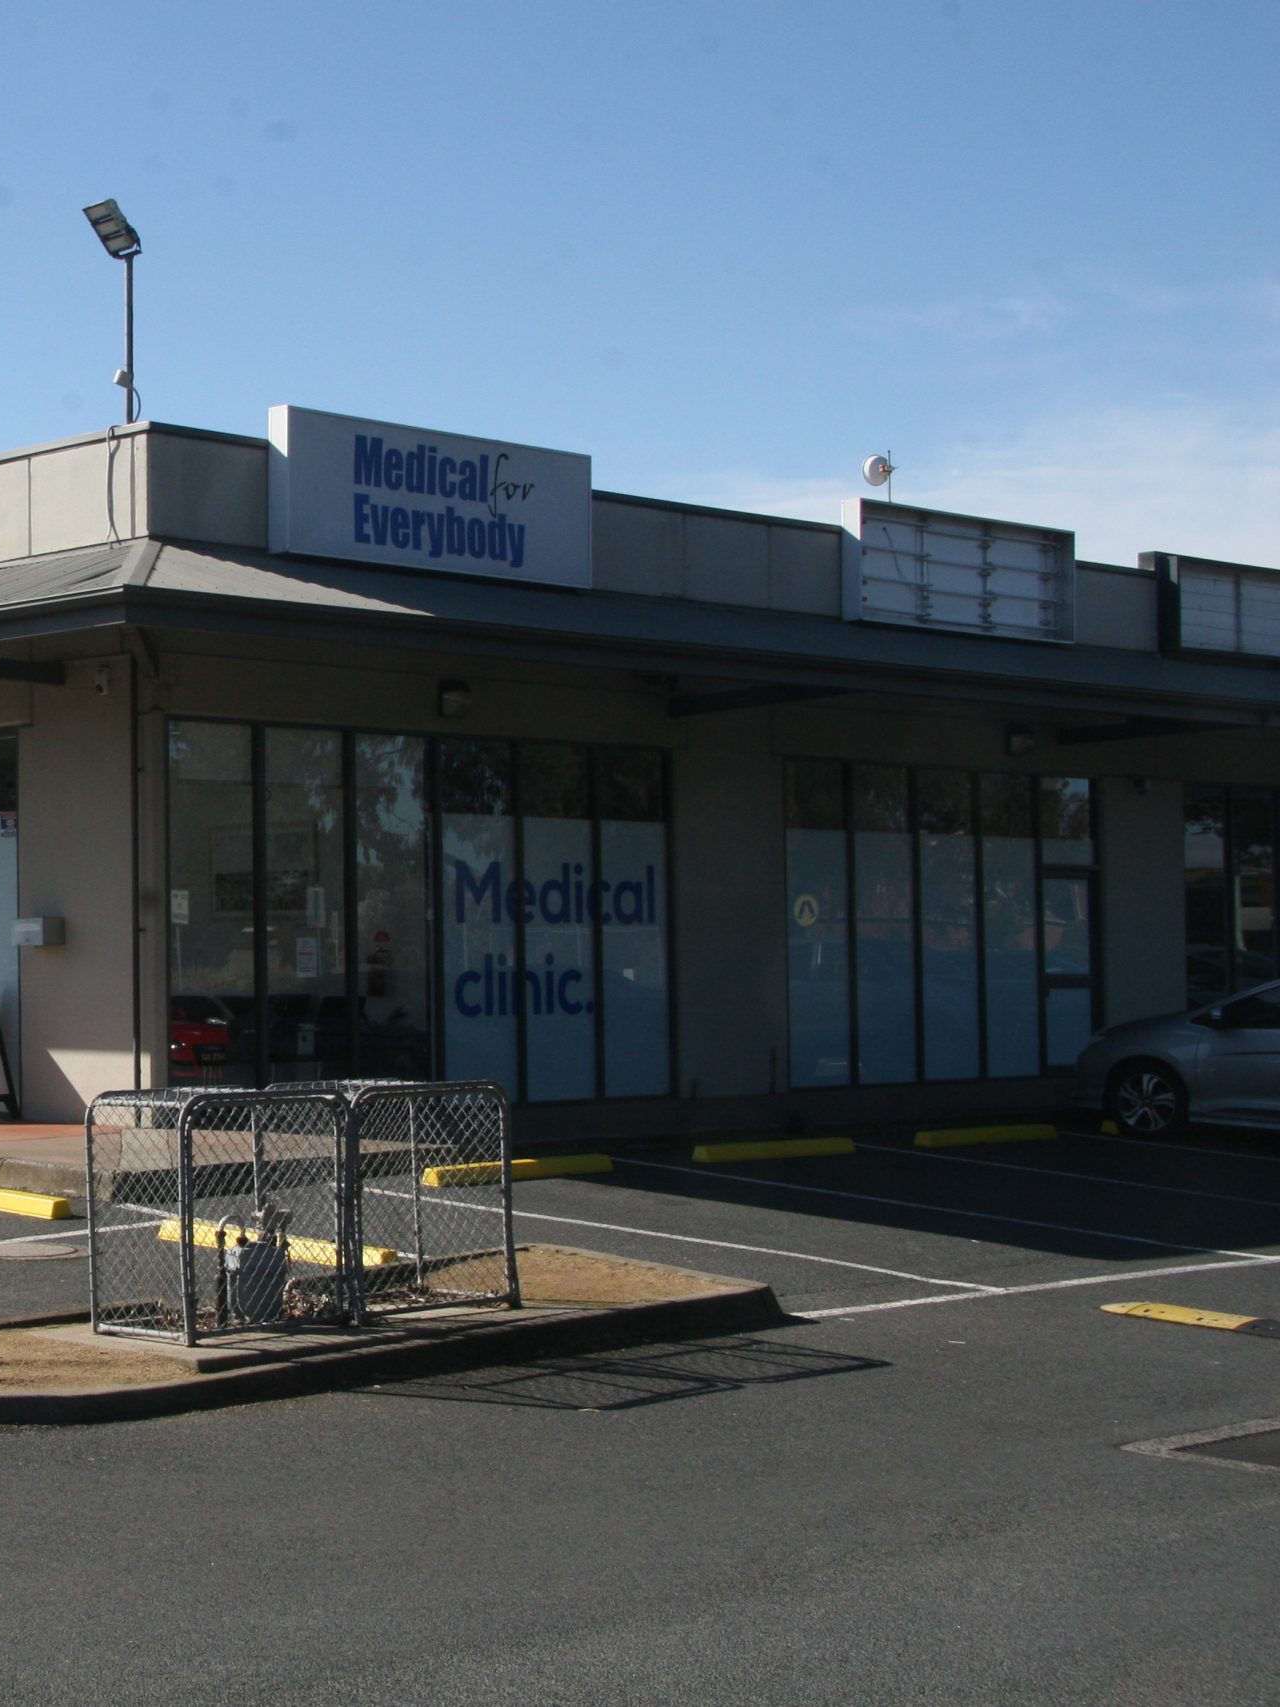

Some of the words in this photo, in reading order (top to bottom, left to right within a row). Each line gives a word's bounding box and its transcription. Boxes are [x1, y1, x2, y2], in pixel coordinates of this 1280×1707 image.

[353, 434, 489, 503] Medical
[488, 453, 535, 517] for
[353, 493, 525, 568] Everybody
[455, 860, 656, 926] Medical
